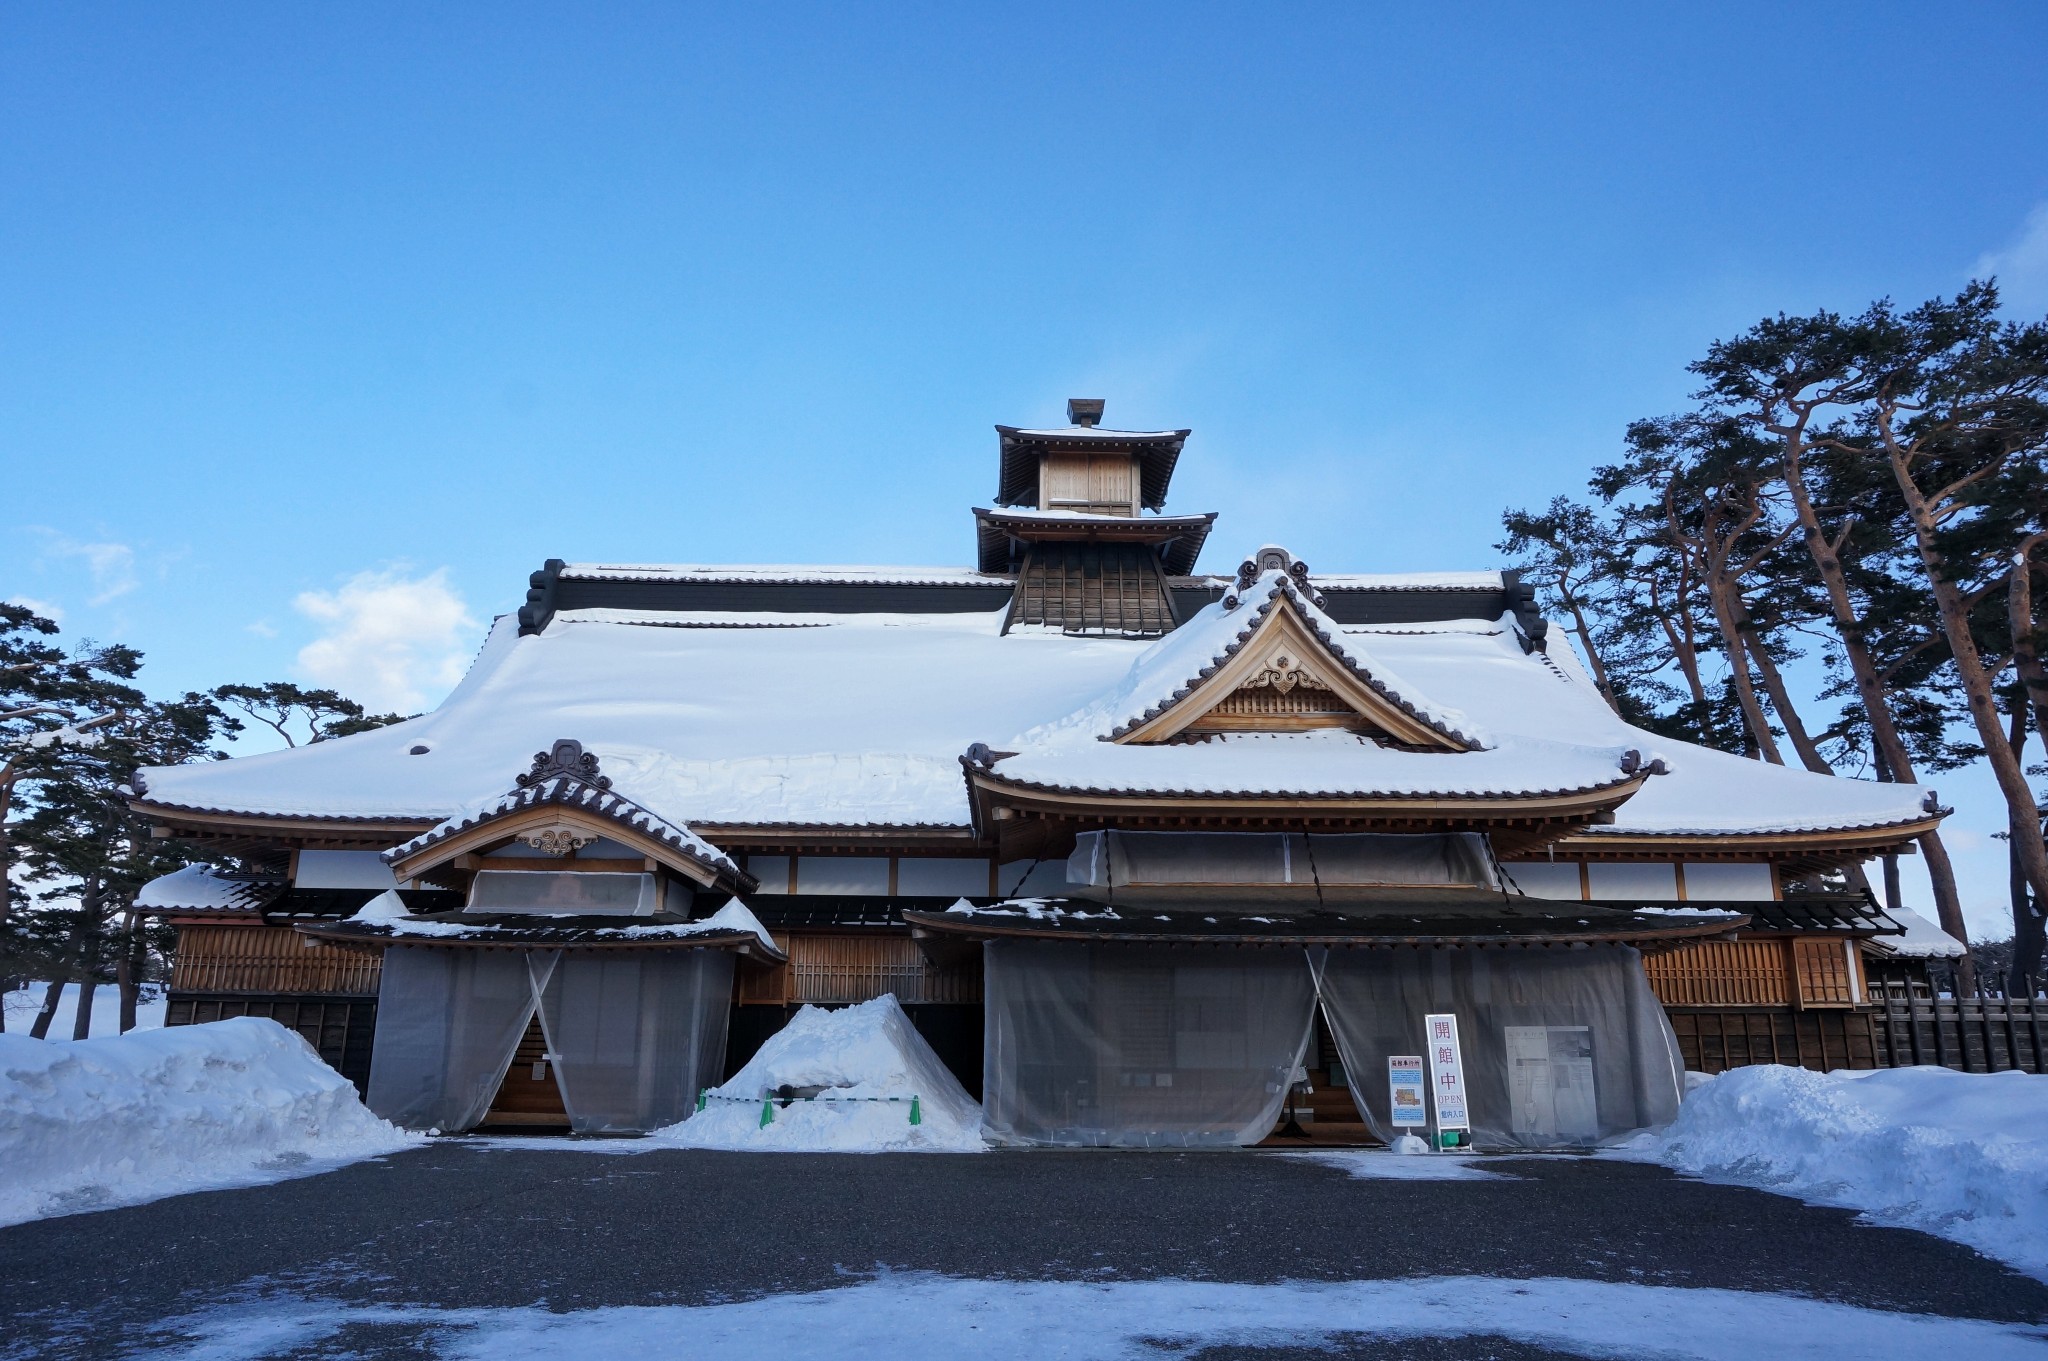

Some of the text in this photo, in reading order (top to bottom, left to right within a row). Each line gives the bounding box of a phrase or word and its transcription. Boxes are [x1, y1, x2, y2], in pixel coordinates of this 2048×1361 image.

[1434, 1021, 1456, 1090] 開館中
[1438, 1094, 1463, 1104] OPEN
[1441, 1109, 1464, 1119] 館内入口
